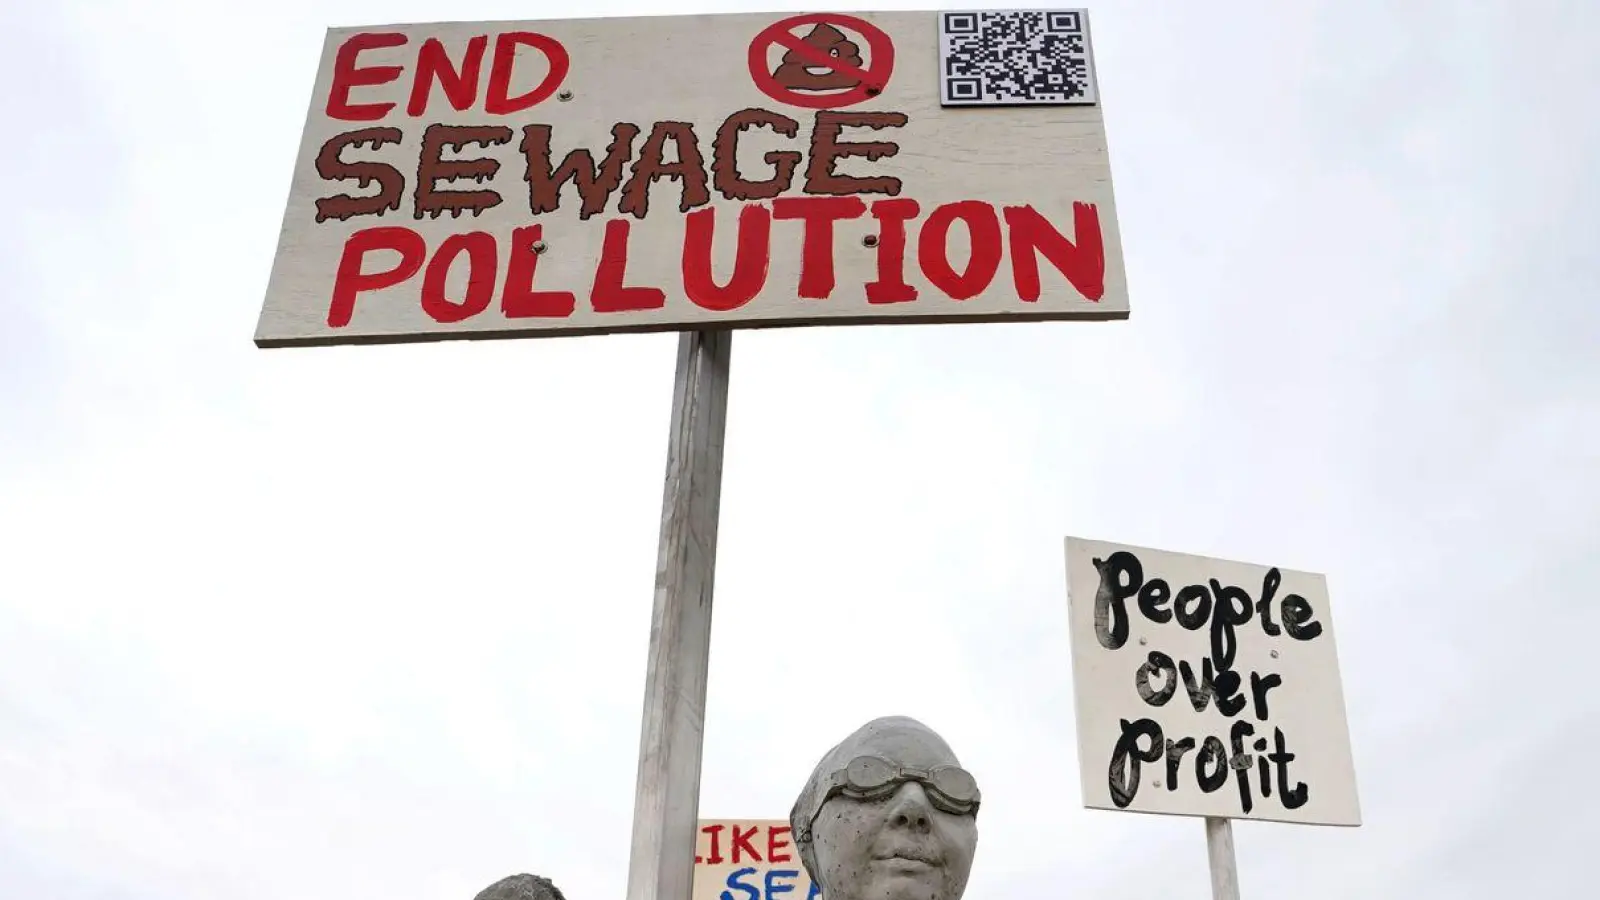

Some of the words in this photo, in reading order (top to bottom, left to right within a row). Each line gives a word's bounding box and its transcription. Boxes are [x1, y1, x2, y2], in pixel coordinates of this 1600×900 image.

[327, 31, 569, 121] END
[314, 107, 909, 224] SEWAGE
[328, 196, 1106, 328] POLLUTION
[1136, 650, 1283, 721] over
[694, 824, 792, 865] IKE
